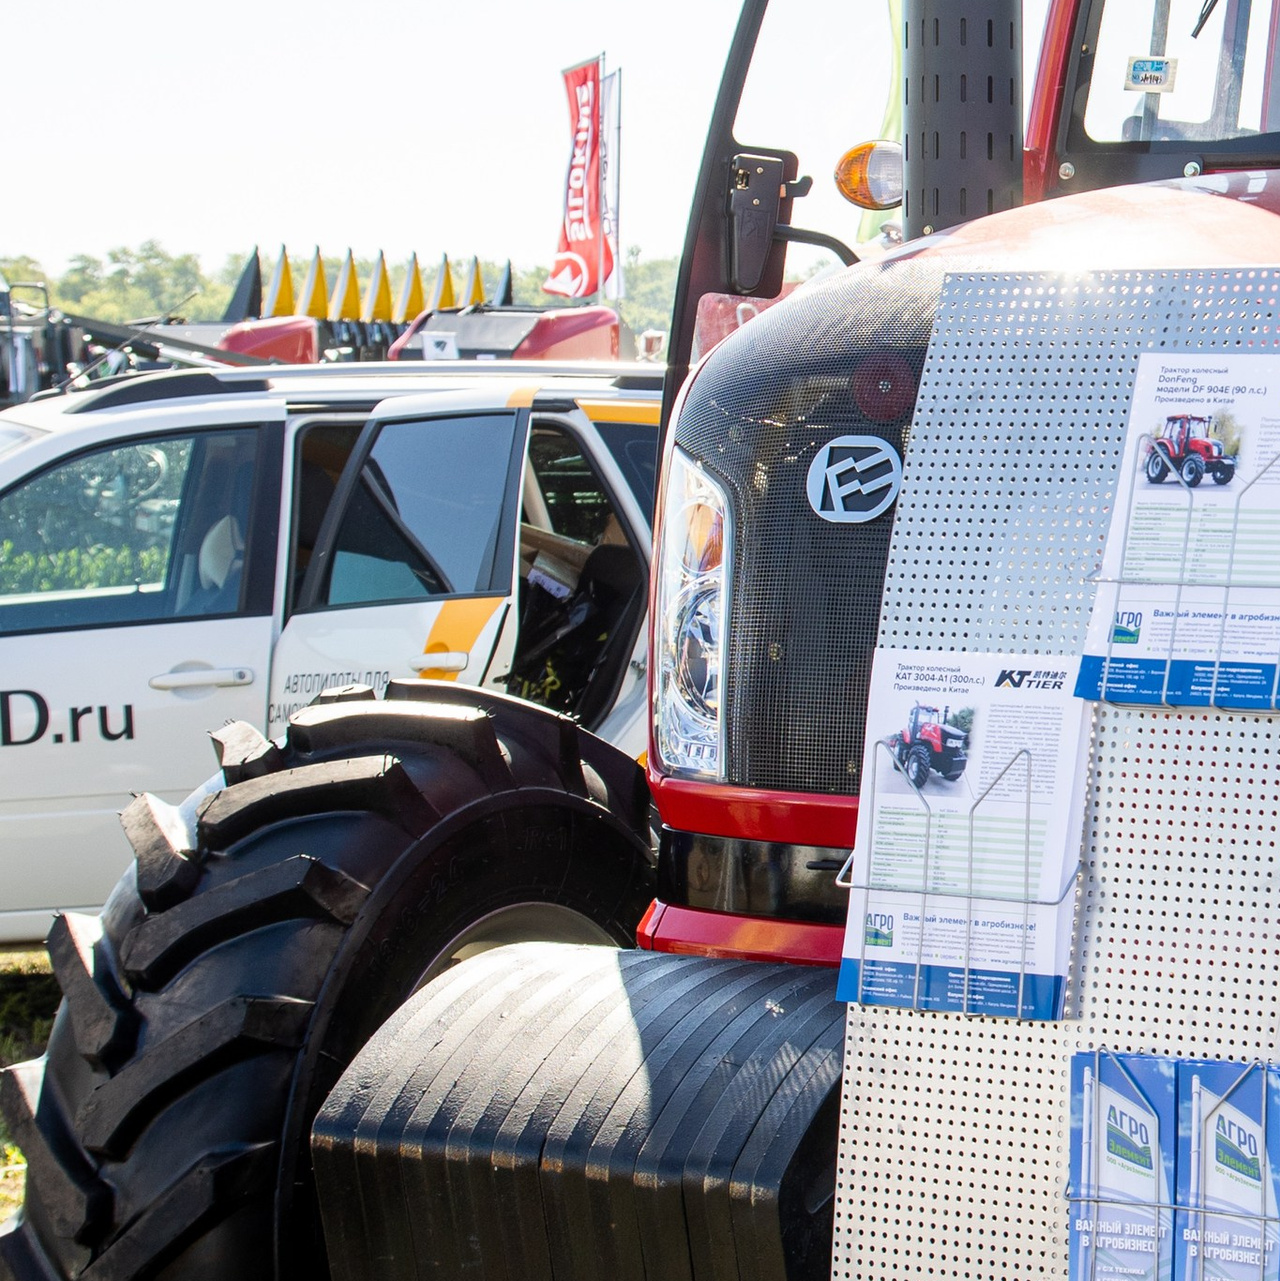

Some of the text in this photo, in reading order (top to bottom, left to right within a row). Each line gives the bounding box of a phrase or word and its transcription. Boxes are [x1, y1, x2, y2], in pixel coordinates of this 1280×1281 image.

[1161, 366, 1228, 374] Трактор колесный
[1158, 375, 1197, 384] DonFeng
[1192, 385, 1204, 393] DF
[1206, 385, 1229, 394] 904E
[1154, 395, 1204, 404] Произведено
[1212, 396, 1235, 404] Китае
[897, 663, 961, 673] Трактор колесный
[894, 684, 941, 693] Произведено
[949, 686, 969, 694] Китае
[1026, 680, 1064, 690] TIER
[903, 913, 936, 923] Важый
[1107, 1104, 1149, 1145] АГРО
[1216, 1113, 1258, 1156] АГРО
[1109, 1138, 1149, 1166] Элемент
[1218, 1148, 1259, 1178] Элемент
[1082, 1235, 1090, 1247] В
[1190, 1245, 1268, 1266] В АГРОБИЗНЕС!
[1115, 1267, 1145, 1275] ТЕХНИКА
